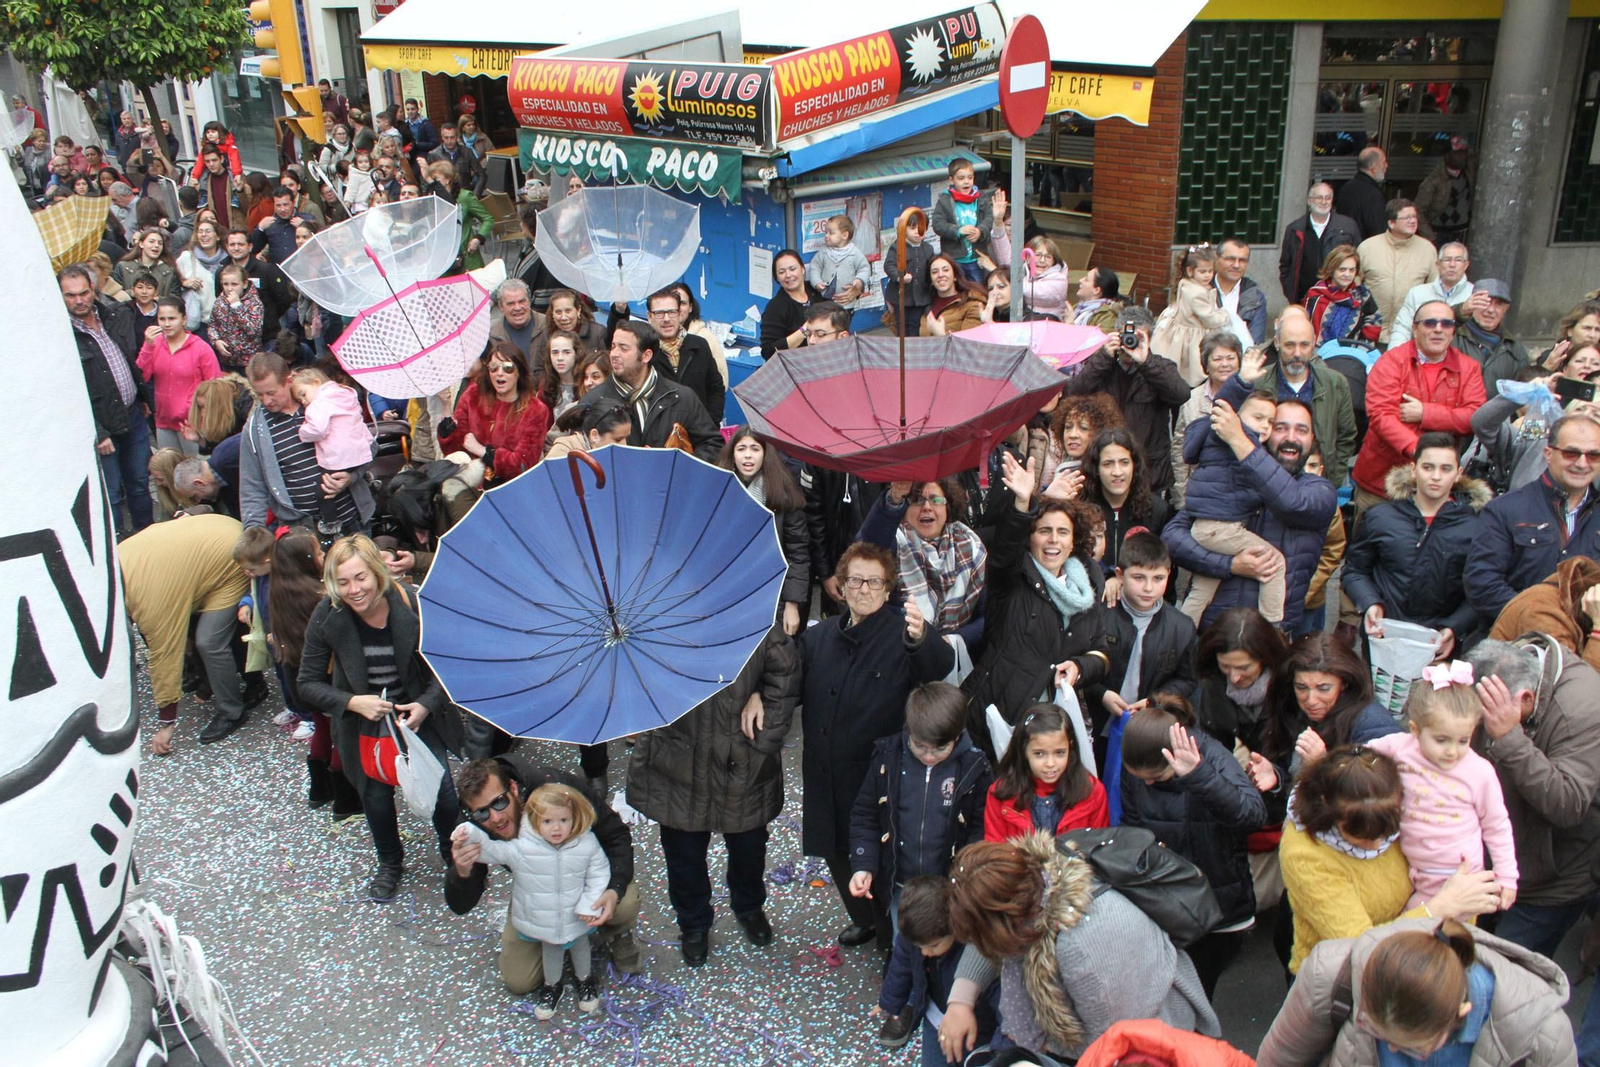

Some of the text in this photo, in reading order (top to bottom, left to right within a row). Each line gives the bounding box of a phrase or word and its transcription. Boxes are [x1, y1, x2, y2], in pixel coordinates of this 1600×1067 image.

[399, 47, 416, 59] SPORT
[472, 48, 521, 71] CATEDR
[776, 35, 891, 98] KIOSCO PACO
[513, 61, 620, 96] KIOSCO PACO
[674, 70, 762, 101] PUIG
[1069, 73, 1104, 96] CAFÉ
[522, 97, 608, 115] ESPECIALIDAD EN
[794, 77, 885, 116] ESPECIALIDAD EN
[521, 114, 624, 132] CHUCHES Y HELADOS
[783, 94, 890, 137] CHUCHES Y HELADOS
[706, 132, 723, 142] 959
[532, 134, 719, 182] KIOSCO PACO
